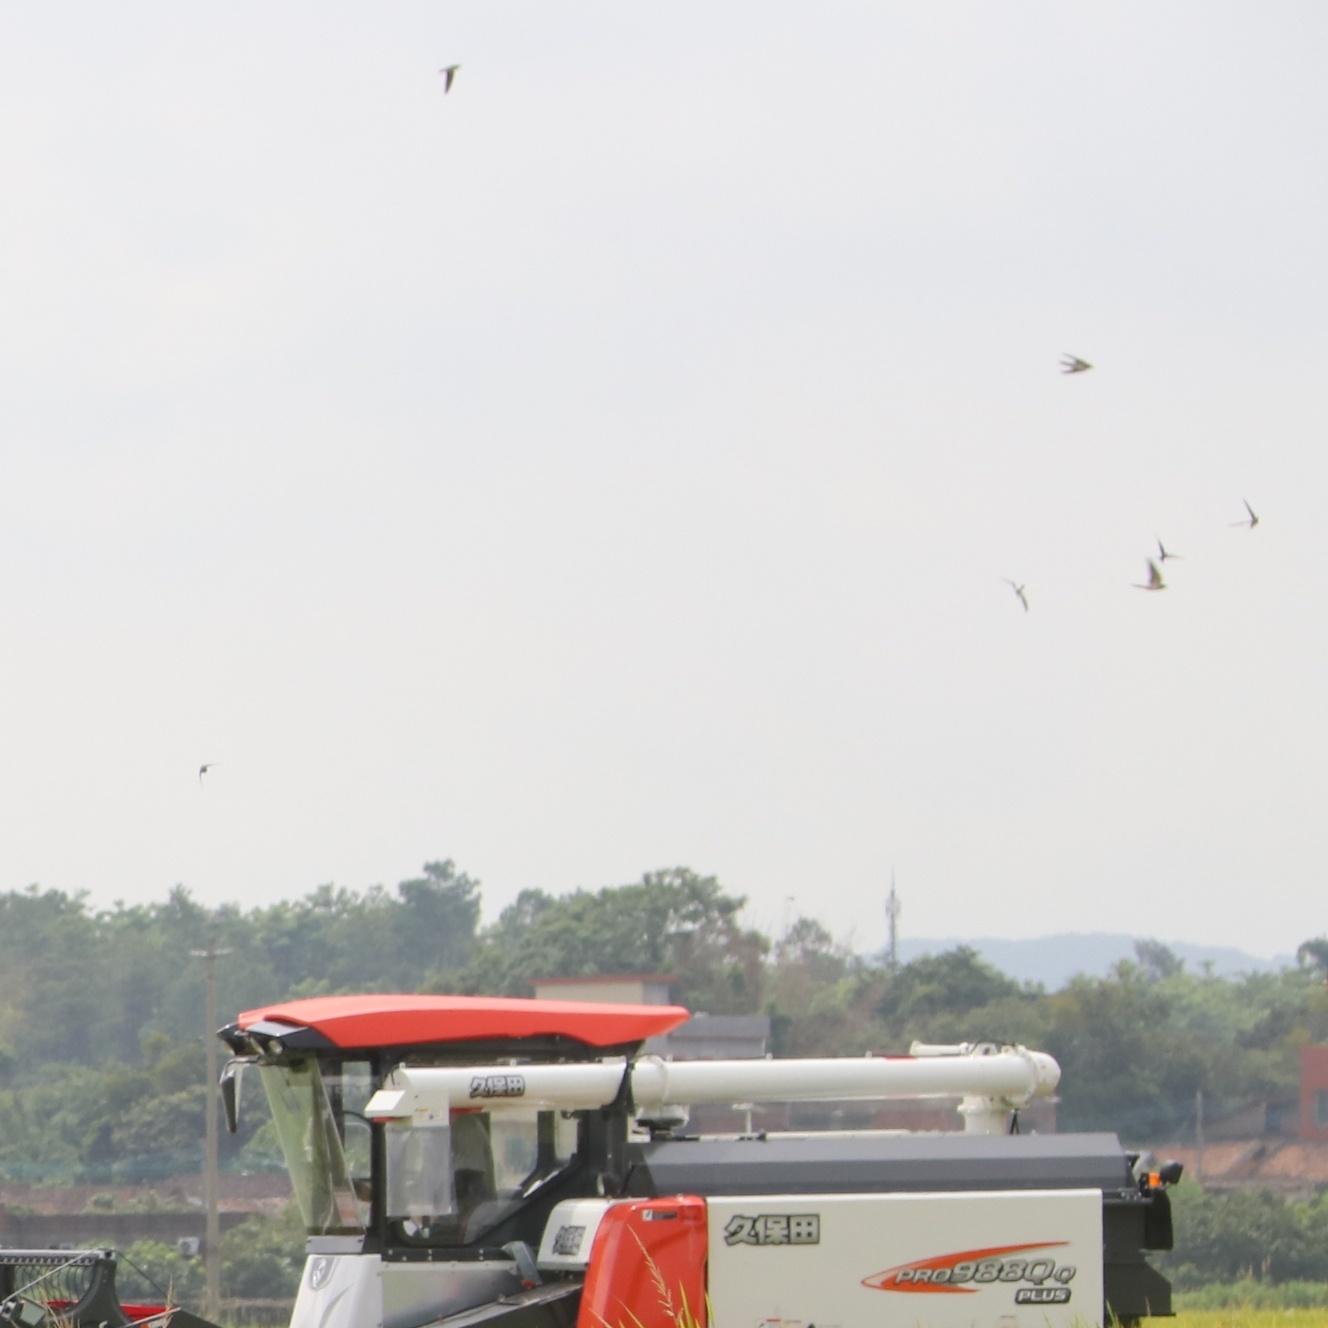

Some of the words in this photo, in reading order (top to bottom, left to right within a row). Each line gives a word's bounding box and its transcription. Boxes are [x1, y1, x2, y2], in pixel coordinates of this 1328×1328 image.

[470, 1075, 525, 1097] 久保田
[724, 1214, 820, 1245] 久保田
[1017, 1289, 1069, 1302] PLUS
